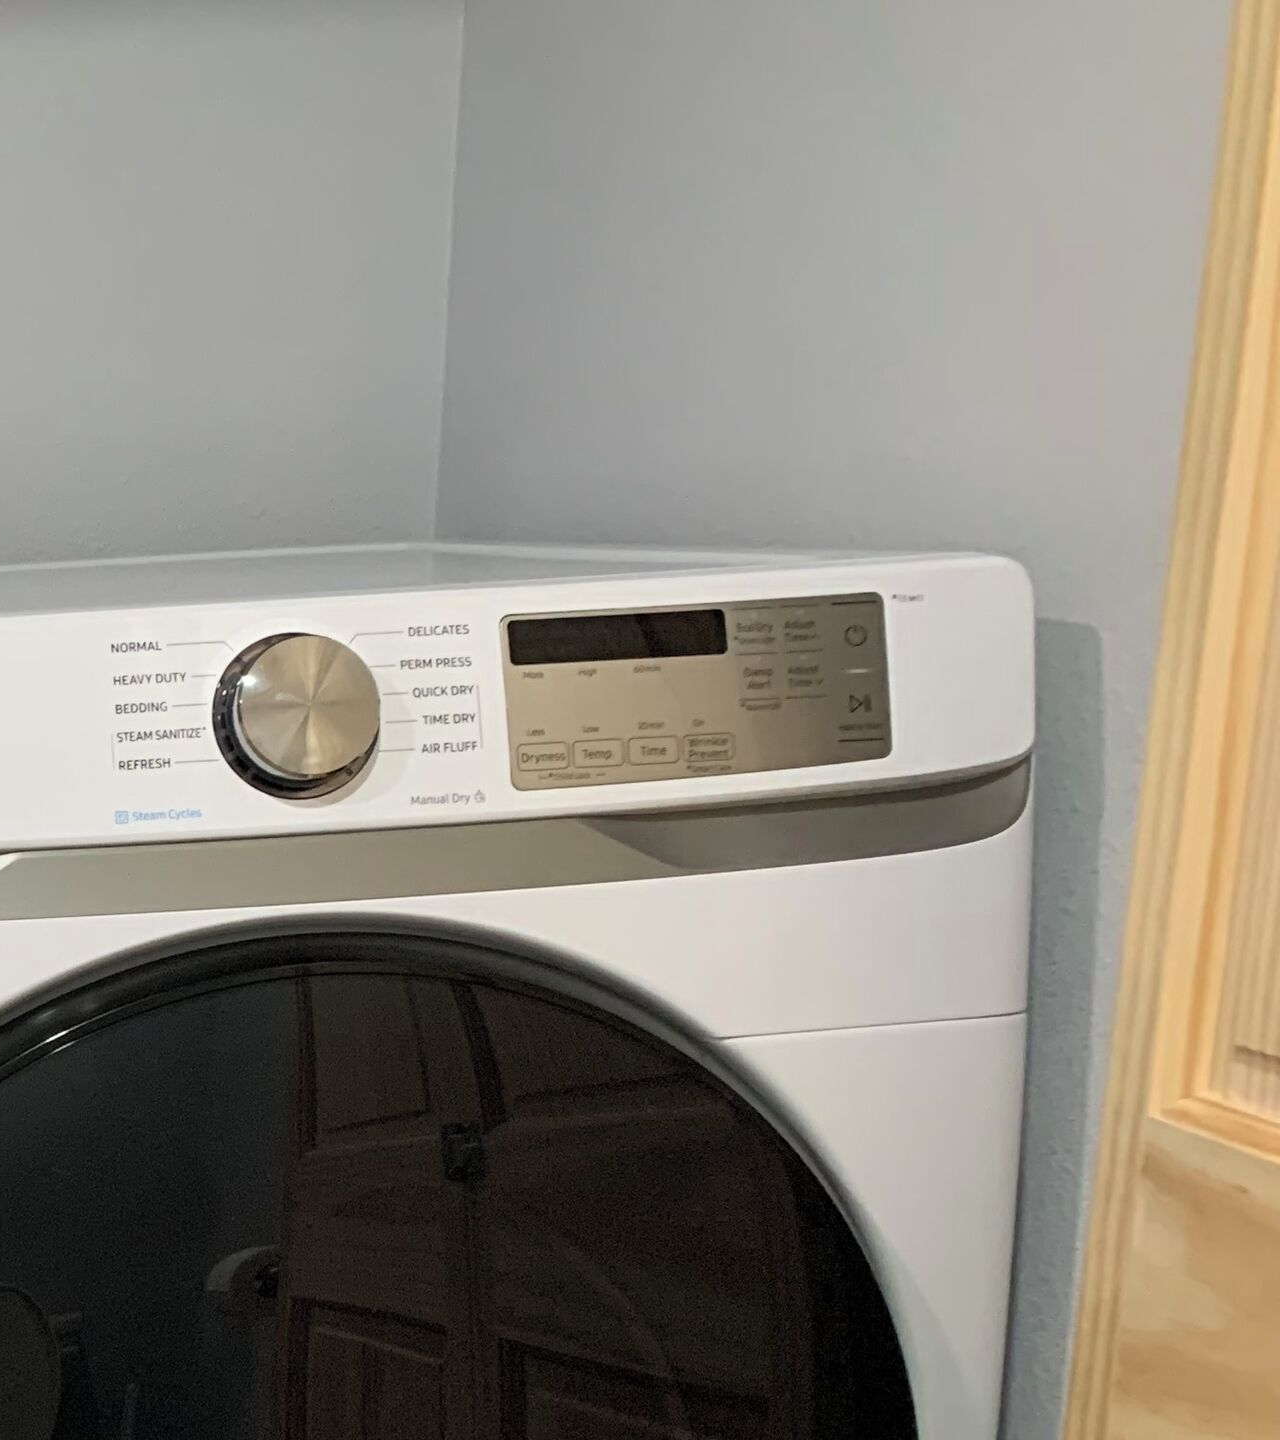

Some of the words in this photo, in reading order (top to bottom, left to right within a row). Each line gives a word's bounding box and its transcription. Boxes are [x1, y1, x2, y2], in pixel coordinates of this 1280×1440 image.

[407, 624, 470, 637] DELICATES
[110, 641, 162, 653] NORMAL
[400, 658, 433, 670] PERM
[435, 656, 472, 668] PRESS
[113, 674, 152, 686] HEAVY
[155, 671, 187, 684] DUTY
[412, 686, 448, 699] QUICK
[450, 685, 474, 696] DRY
[115, 701, 168, 715] BEDDING
[422, 713, 450, 725] TIME
[453, 713, 476, 725] DRY
[116, 731, 153, 743] STEAM
[421, 742, 441, 754] AIR
[443, 740, 478, 752] FLUFF
[118, 757, 171, 771] REFRESH
[411, 793, 449, 805] Manual
[452, 792, 471, 805] Dry
